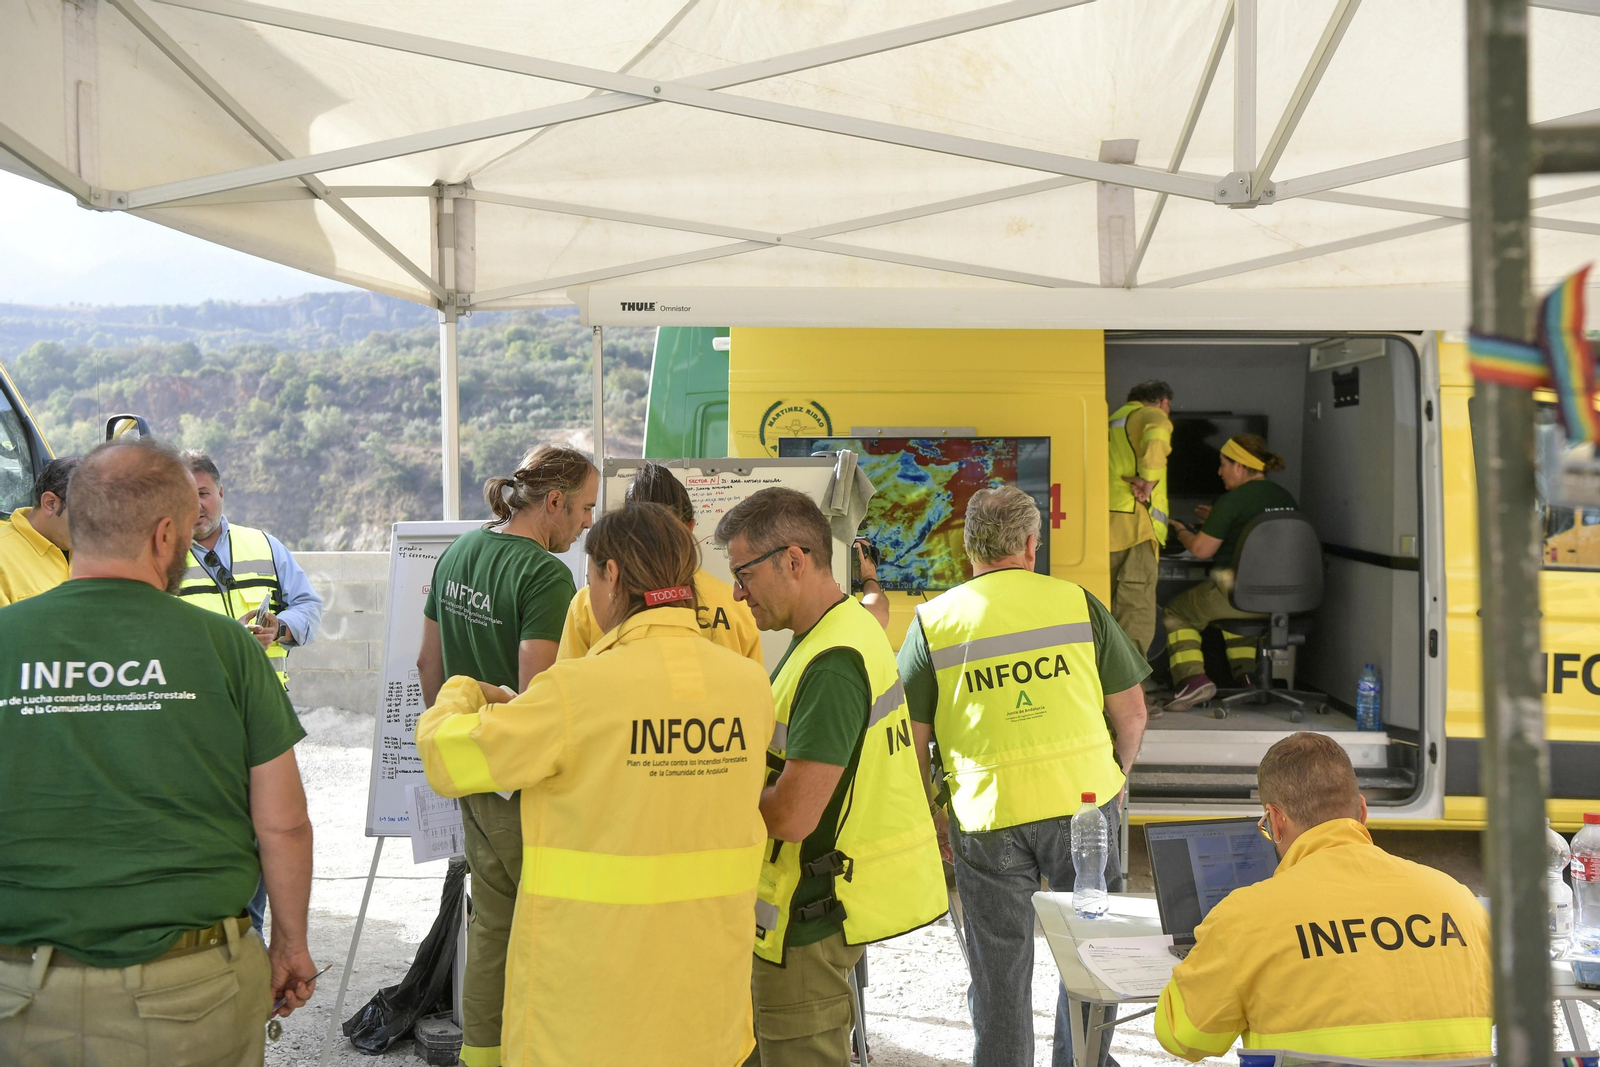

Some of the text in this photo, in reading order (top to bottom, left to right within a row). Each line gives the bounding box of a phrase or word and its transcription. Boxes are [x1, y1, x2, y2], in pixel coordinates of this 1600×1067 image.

[620, 302, 656, 312] THULE
[768, 406, 824, 428] MARTINEZ RIDAO
[650, 588, 689, 602] TODO OK
[20, 659, 166, 690] INFOCA
[965, 654, 1070, 693] INFOCA
[8, 696, 22, 705] de
[23, 694, 53, 704] Lucha
[87, 692, 102, 702] los
[102, 692, 147, 701] Incendios
[148, 690, 196, 700] Forestales
[20, 701, 162, 715] de la Comunidad de Andalucía
[630, 717, 746, 754] INFOCA
[886, 718, 912, 756] IN
[1294, 912, 1467, 959] INFOCA
